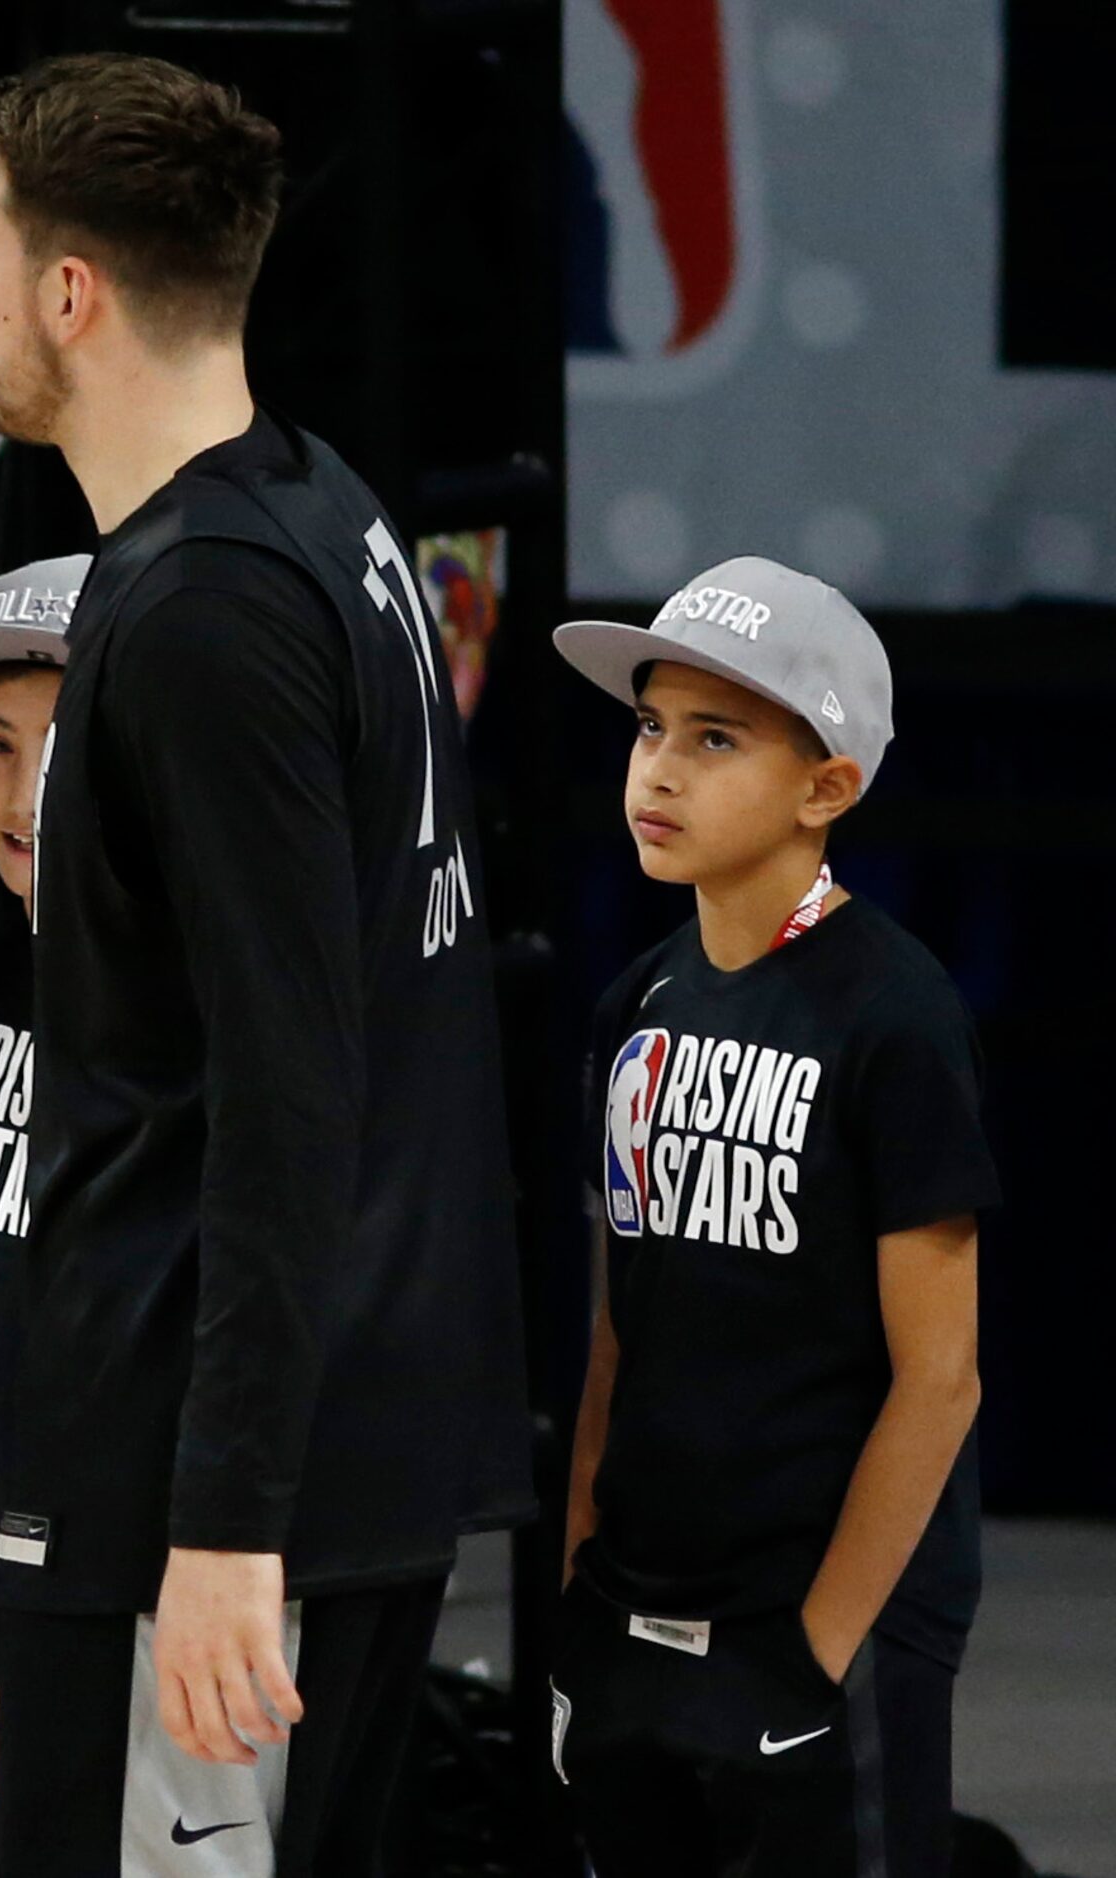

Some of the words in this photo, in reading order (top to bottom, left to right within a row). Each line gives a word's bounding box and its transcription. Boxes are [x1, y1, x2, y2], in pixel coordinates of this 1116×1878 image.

[685, 586, 772, 641] STAR
[658, 1033, 822, 1154] RISING
[648, 1132, 799, 1255] STARS
